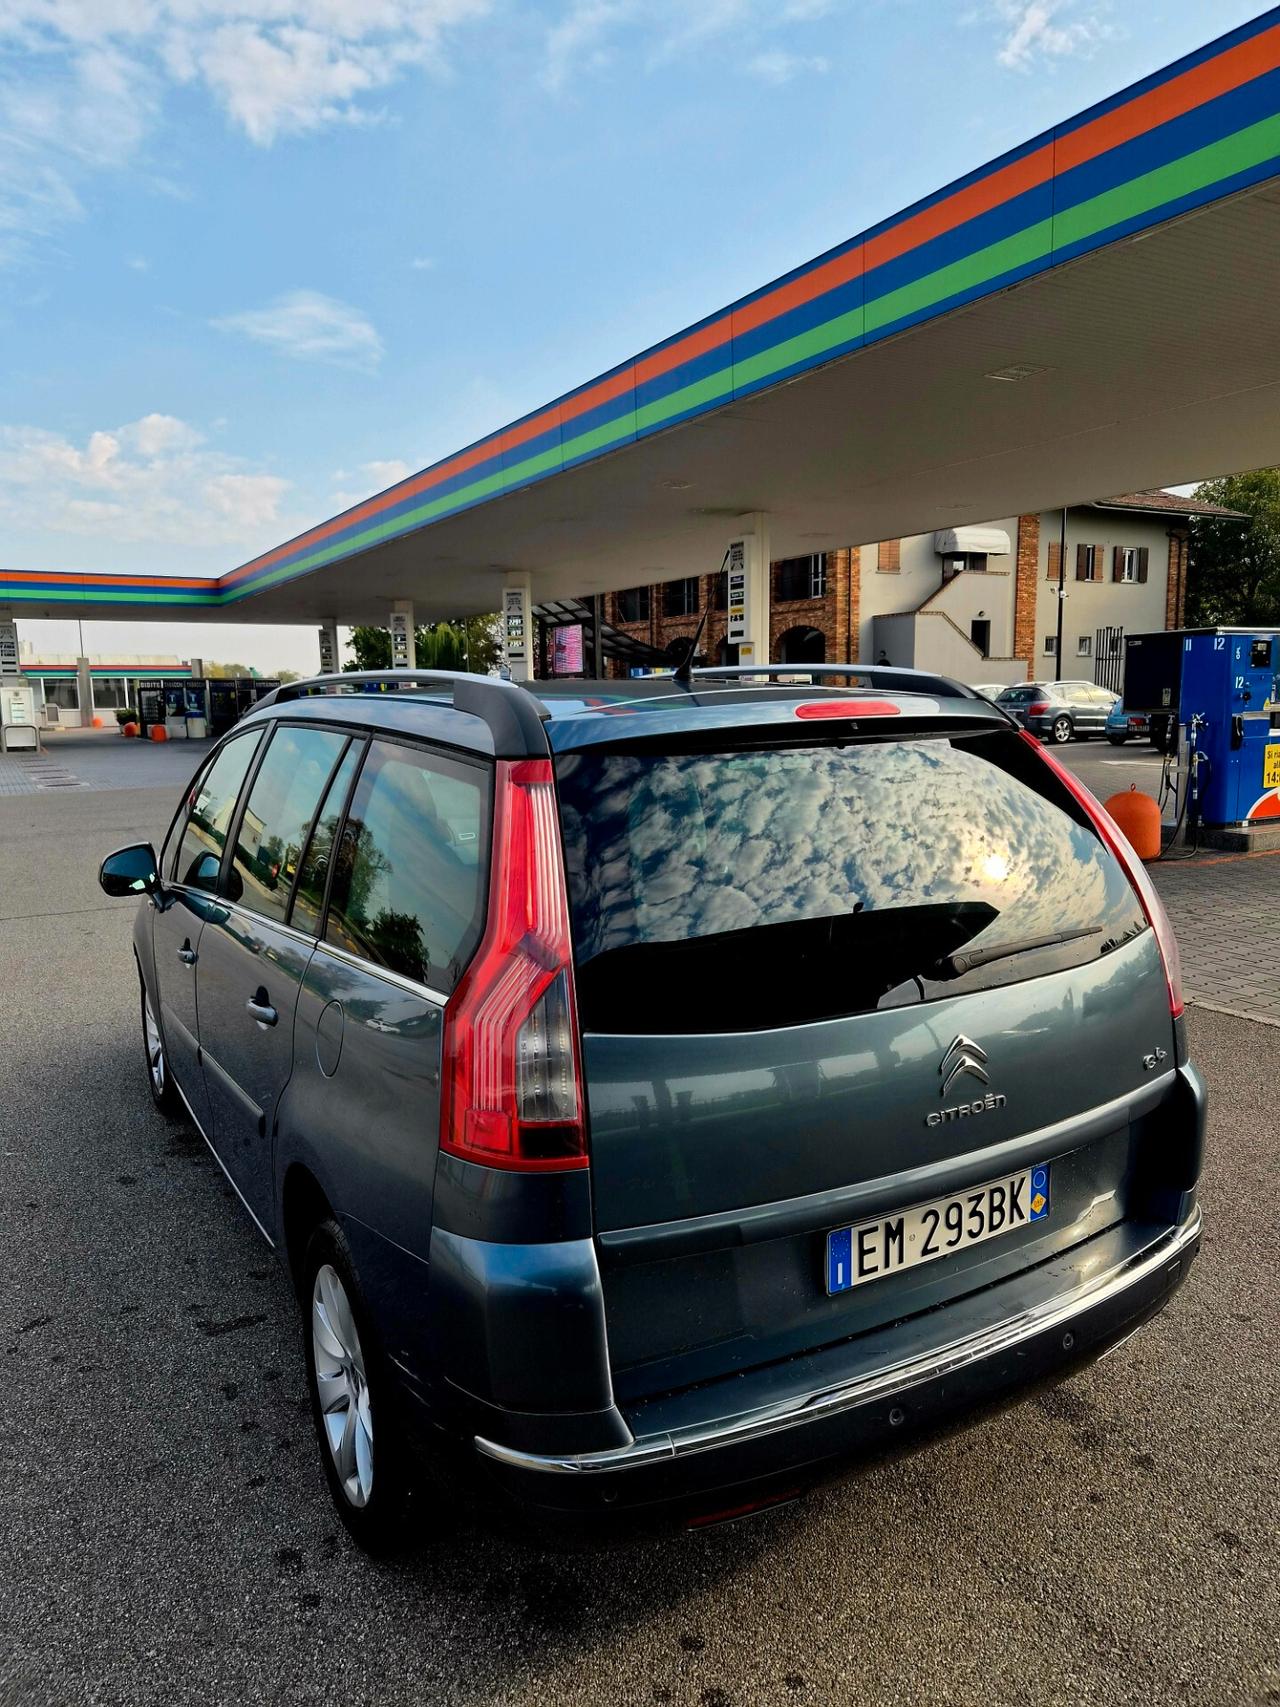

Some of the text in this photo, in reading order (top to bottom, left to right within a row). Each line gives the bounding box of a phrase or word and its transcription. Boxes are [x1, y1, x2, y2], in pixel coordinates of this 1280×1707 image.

[1185, 638, 1192, 651] 11
[1213, 637, 1226, 651] 12
[1235, 676, 1244, 689] 12
[857, 1176, 1026, 1278] EM 293BK
